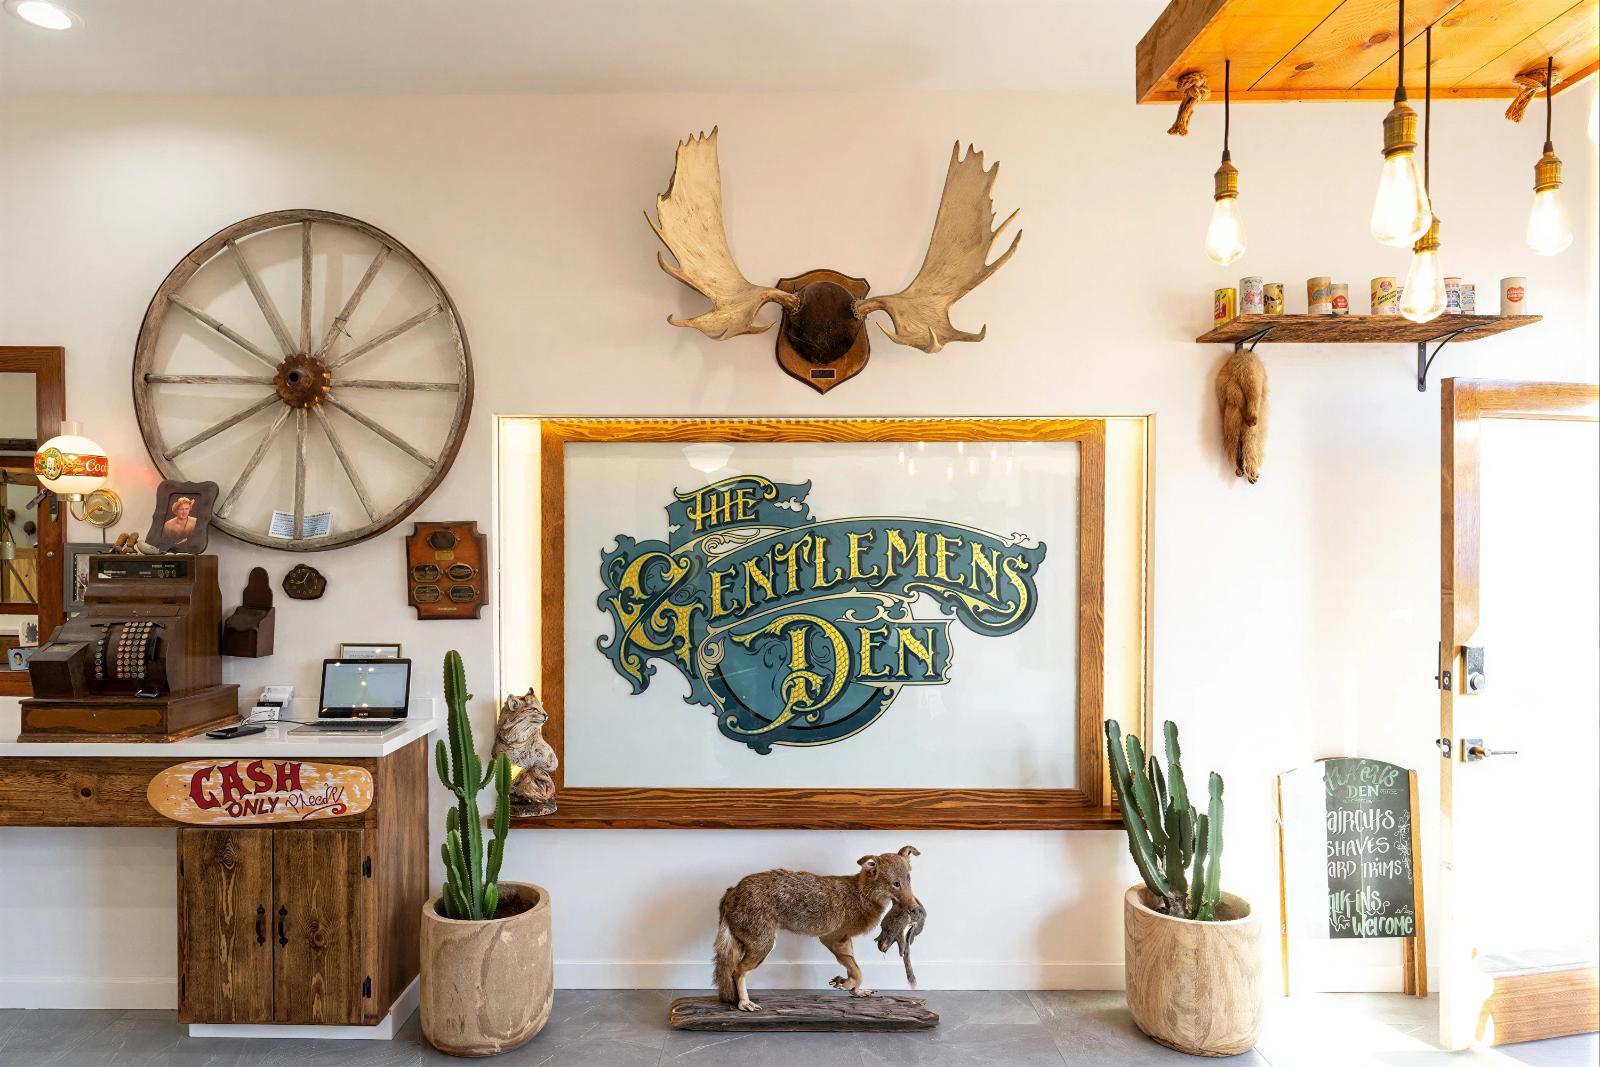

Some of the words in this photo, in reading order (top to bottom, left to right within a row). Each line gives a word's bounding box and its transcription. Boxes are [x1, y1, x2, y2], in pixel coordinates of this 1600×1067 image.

[676, 475, 779, 532] THE
[609, 528, 1029, 684] GENTLEMENS
[730, 613, 943, 735] DEN
[189, 760, 303, 810] CASH
[225, 796, 280, 818] ONLY
[1346, 784, 1380, 799] DEN
[1326, 835, 1390, 858] SHAVES
